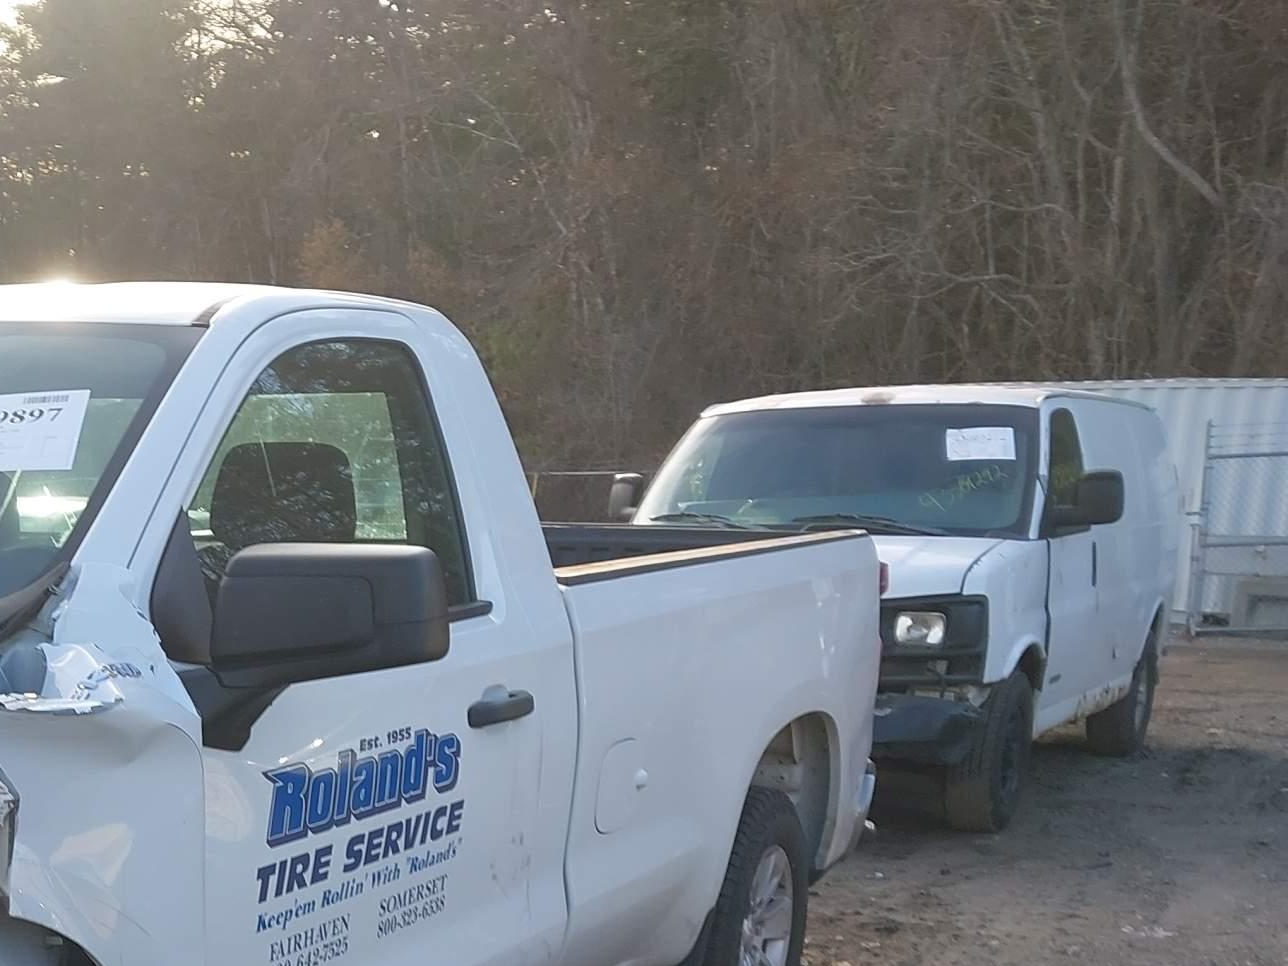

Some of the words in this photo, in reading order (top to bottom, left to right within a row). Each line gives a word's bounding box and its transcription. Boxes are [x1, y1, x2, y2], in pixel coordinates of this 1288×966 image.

[359, 735, 383, 752] Est.
[387, 726, 412, 745] 1955
[261, 729, 464, 848] Roland's
[256, 843, 333, 904] TIRE
[343, 799, 465, 873] SERVICE
[371, 863, 401, 889] With
[378, 874, 448, 917] SOMERSET
[268, 913, 351, 962] FAIRHAVEN
